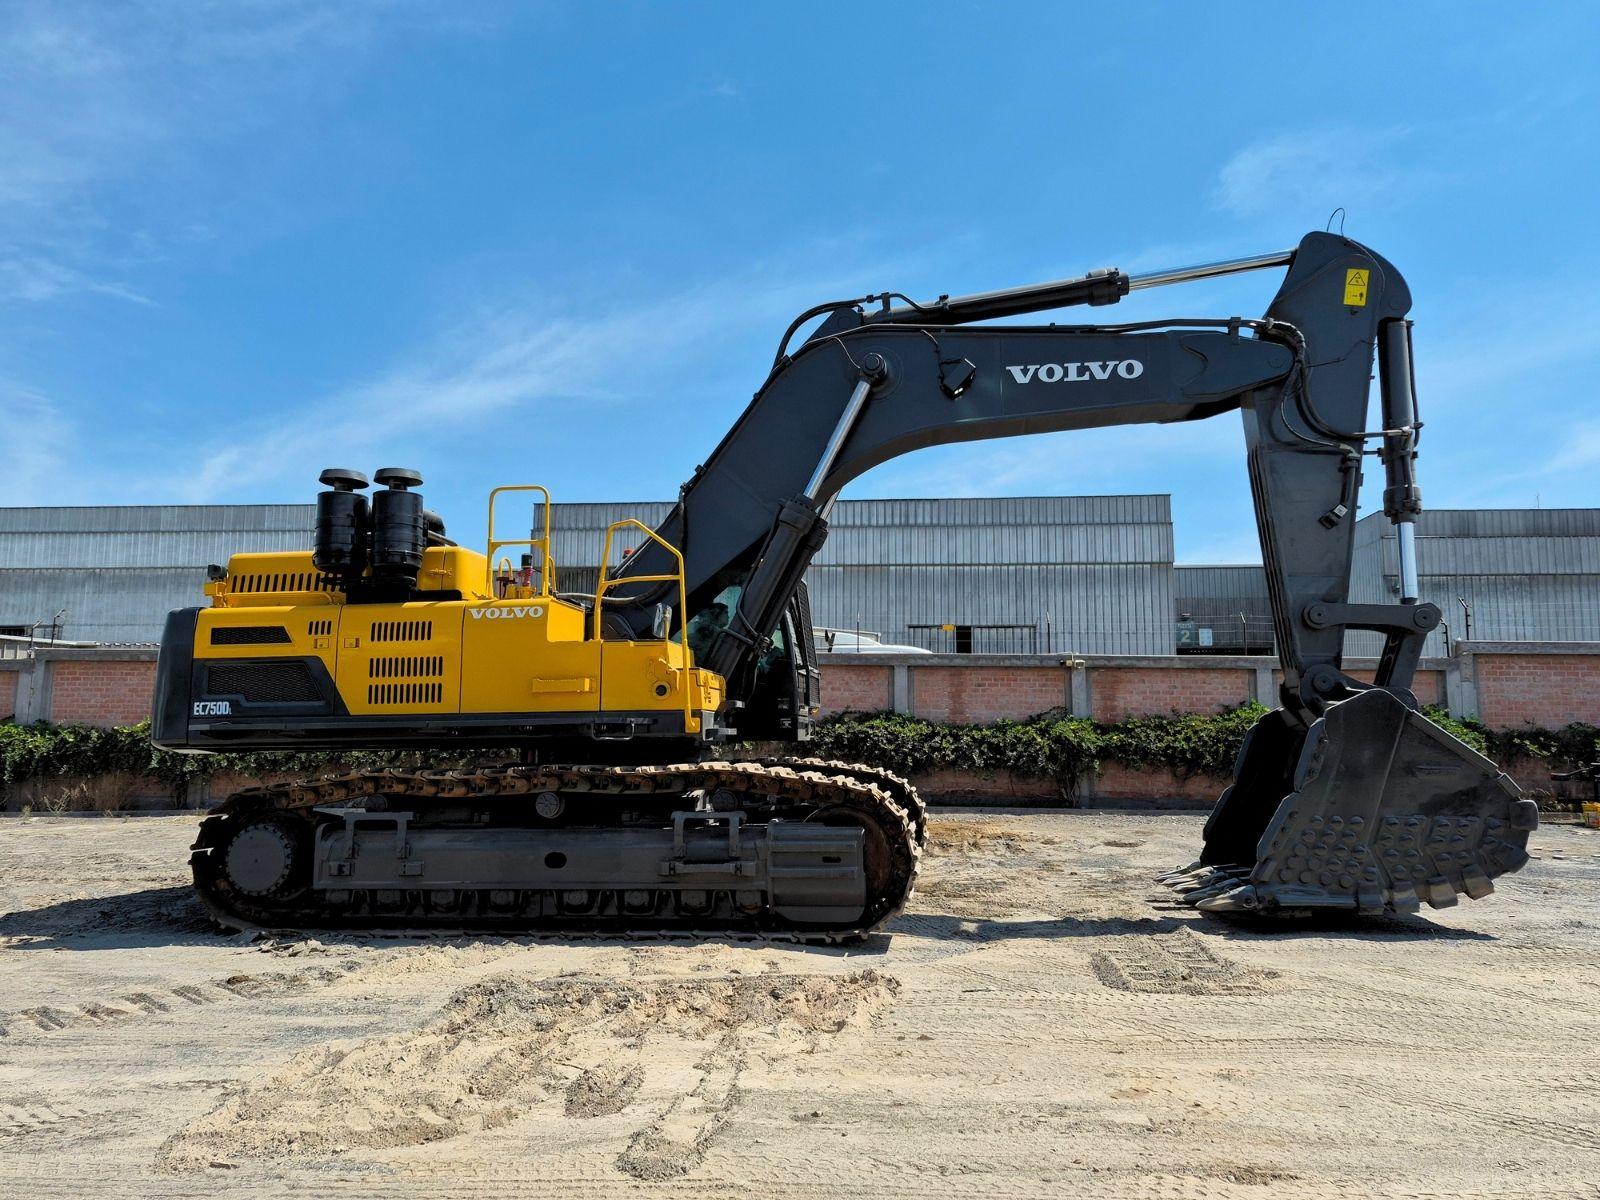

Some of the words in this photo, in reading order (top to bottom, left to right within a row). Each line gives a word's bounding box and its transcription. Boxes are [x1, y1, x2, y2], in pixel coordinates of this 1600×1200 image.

[1006, 359, 1144, 384] VOLVO
[468, 606, 543, 619] VOLVO
[1180, 629, 1191, 643] 2
